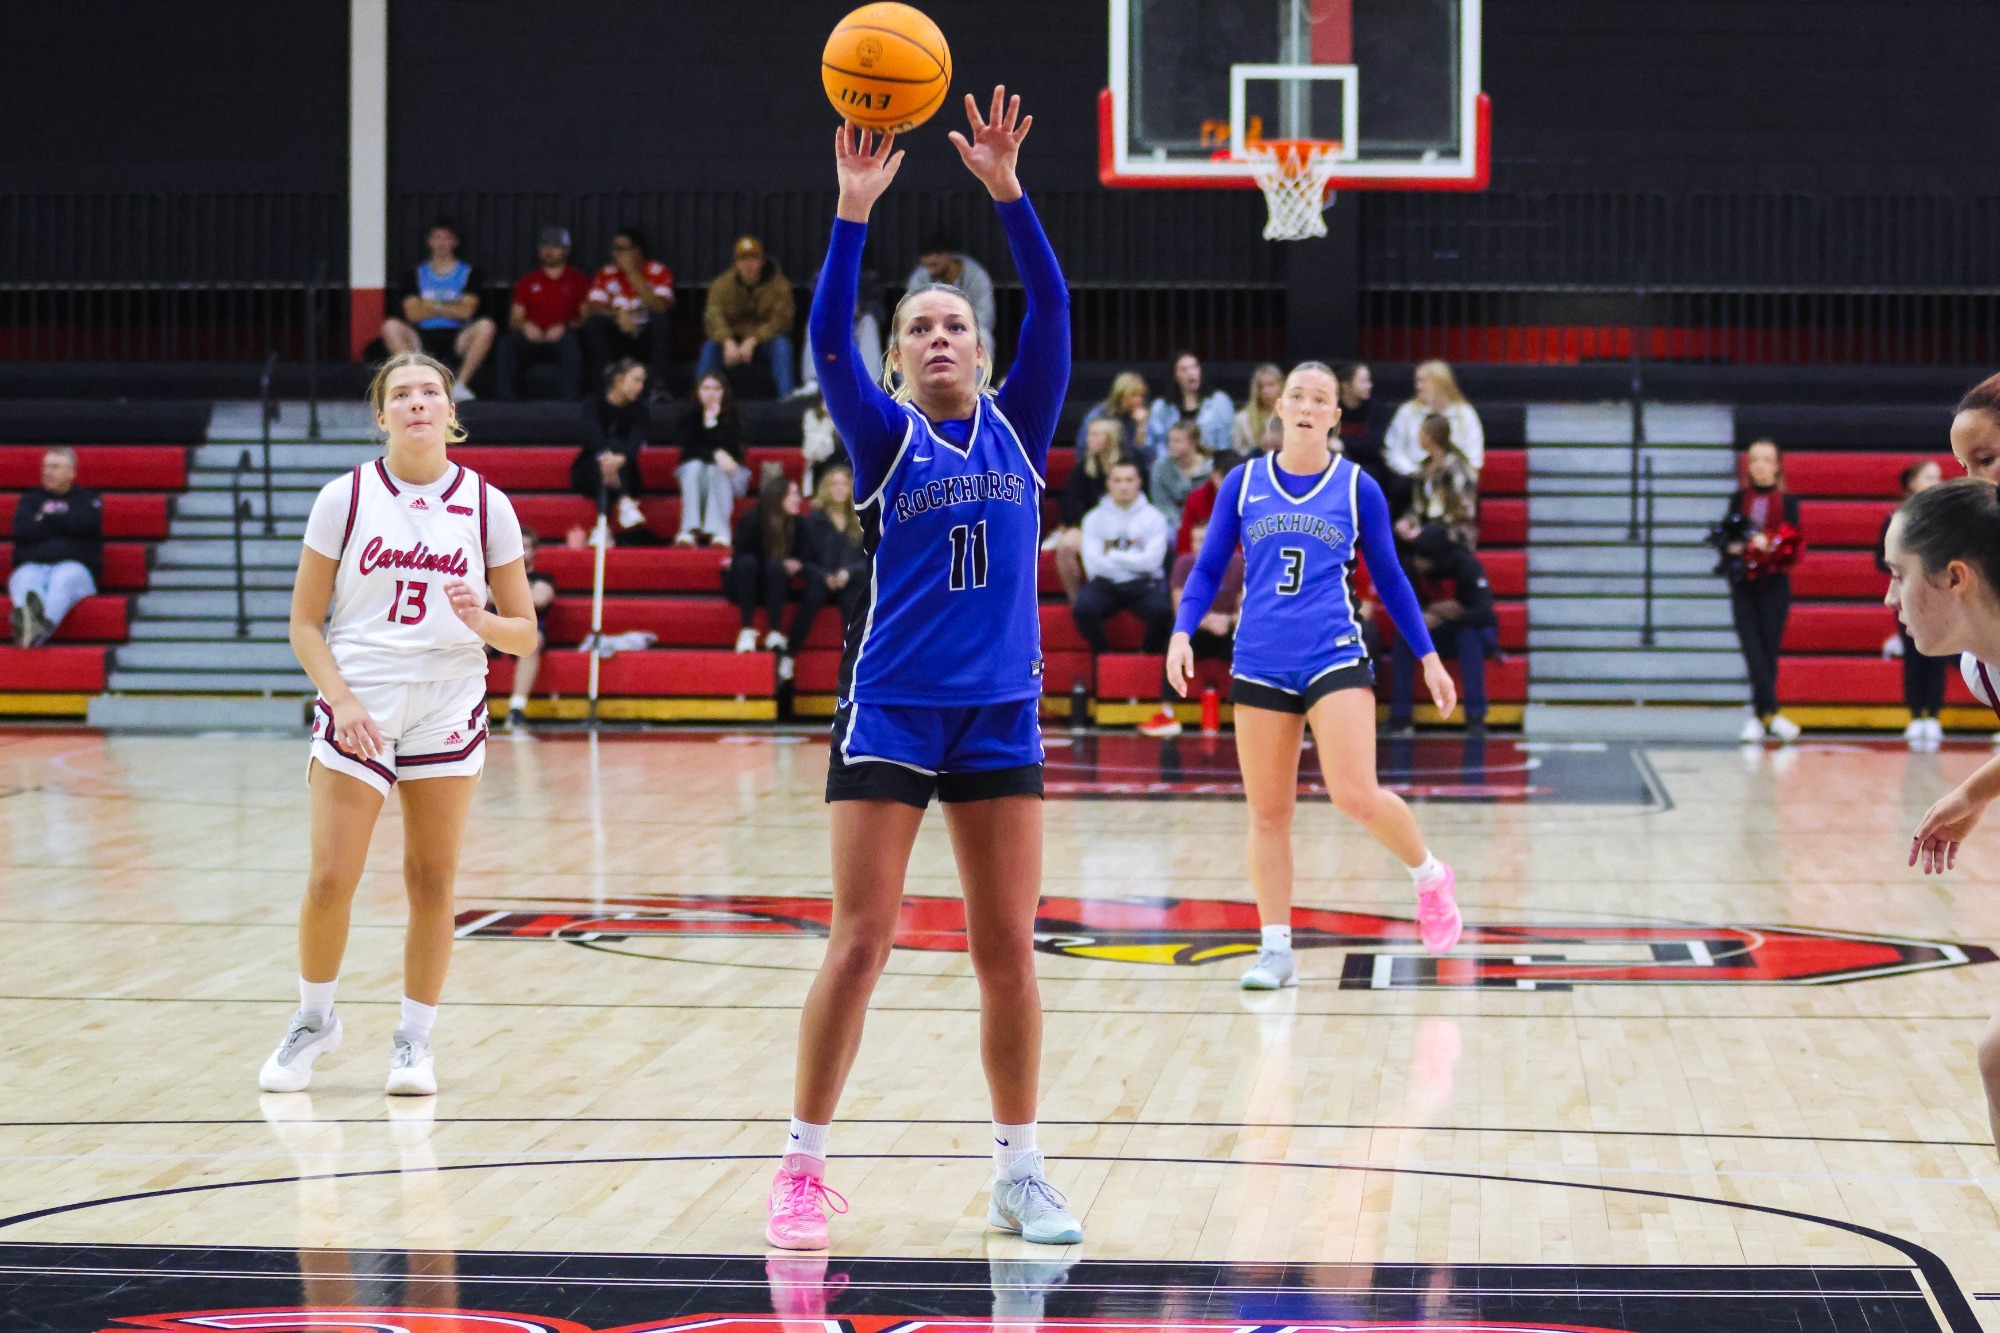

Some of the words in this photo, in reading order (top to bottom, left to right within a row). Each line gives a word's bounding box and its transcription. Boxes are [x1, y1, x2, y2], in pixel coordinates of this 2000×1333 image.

[895, 470, 1026, 523] ROCKHURST
[1247, 513, 1346, 550] ROCKHURST
[359, 535, 469, 578] Cardinals
[949, 519, 989, 592] 11
[1275, 547, 1306, 596] 3
[386, 579, 429, 626] 13
[443, 737, 464, 746] adidas
